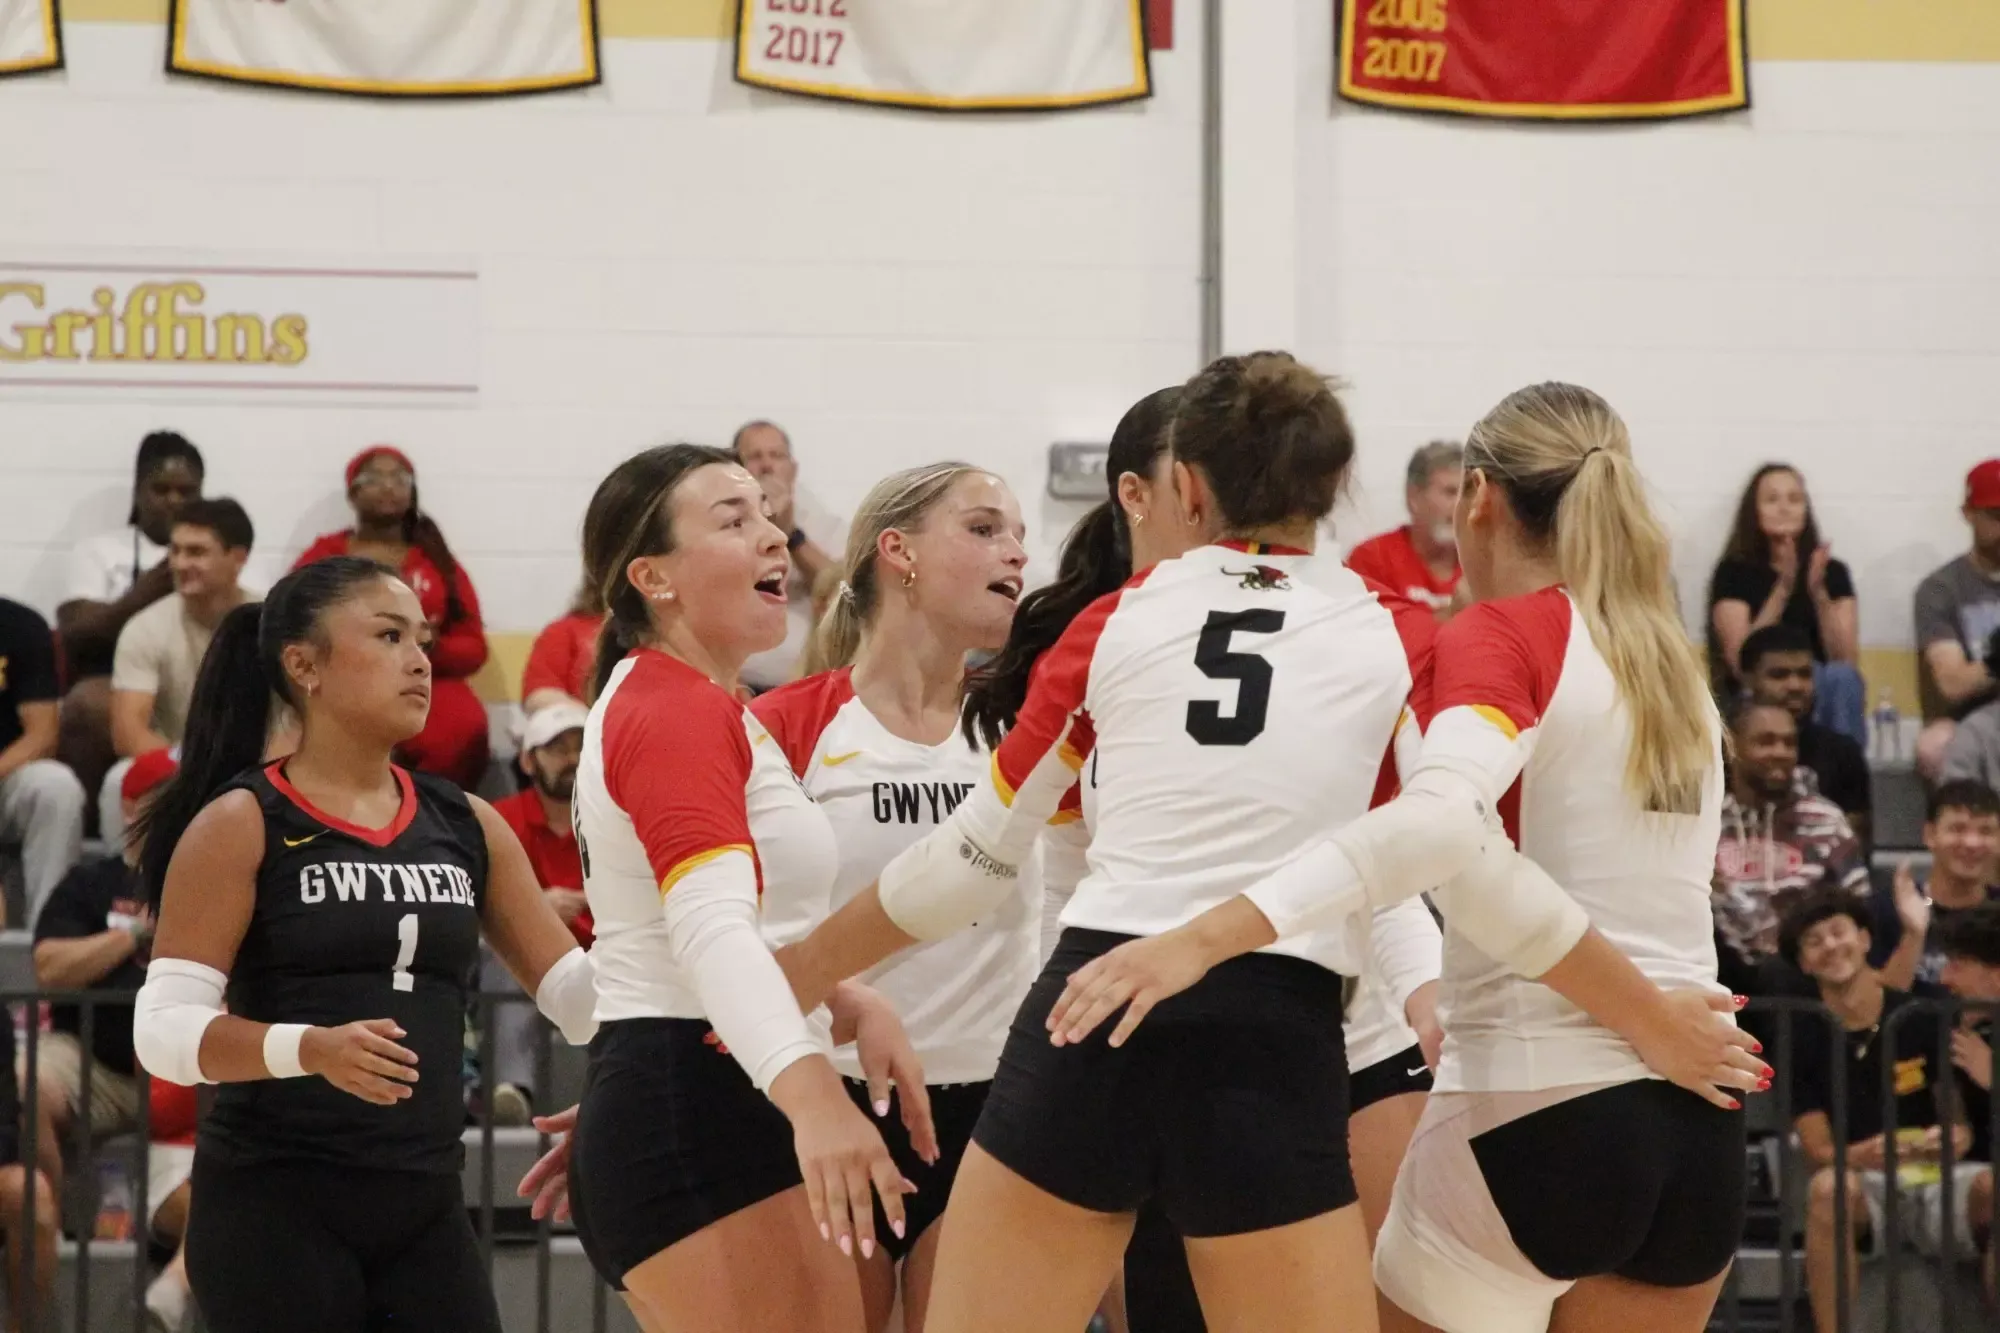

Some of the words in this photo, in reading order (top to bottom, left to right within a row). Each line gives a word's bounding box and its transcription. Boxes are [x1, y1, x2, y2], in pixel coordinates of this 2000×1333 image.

[765, 24, 844, 66] 2017
[1362, 37, 1448, 83] 2007
[0, 280, 309, 364] Griffins
[1185, 608, 1286, 746] 5
[392, 913, 419, 993] 1
